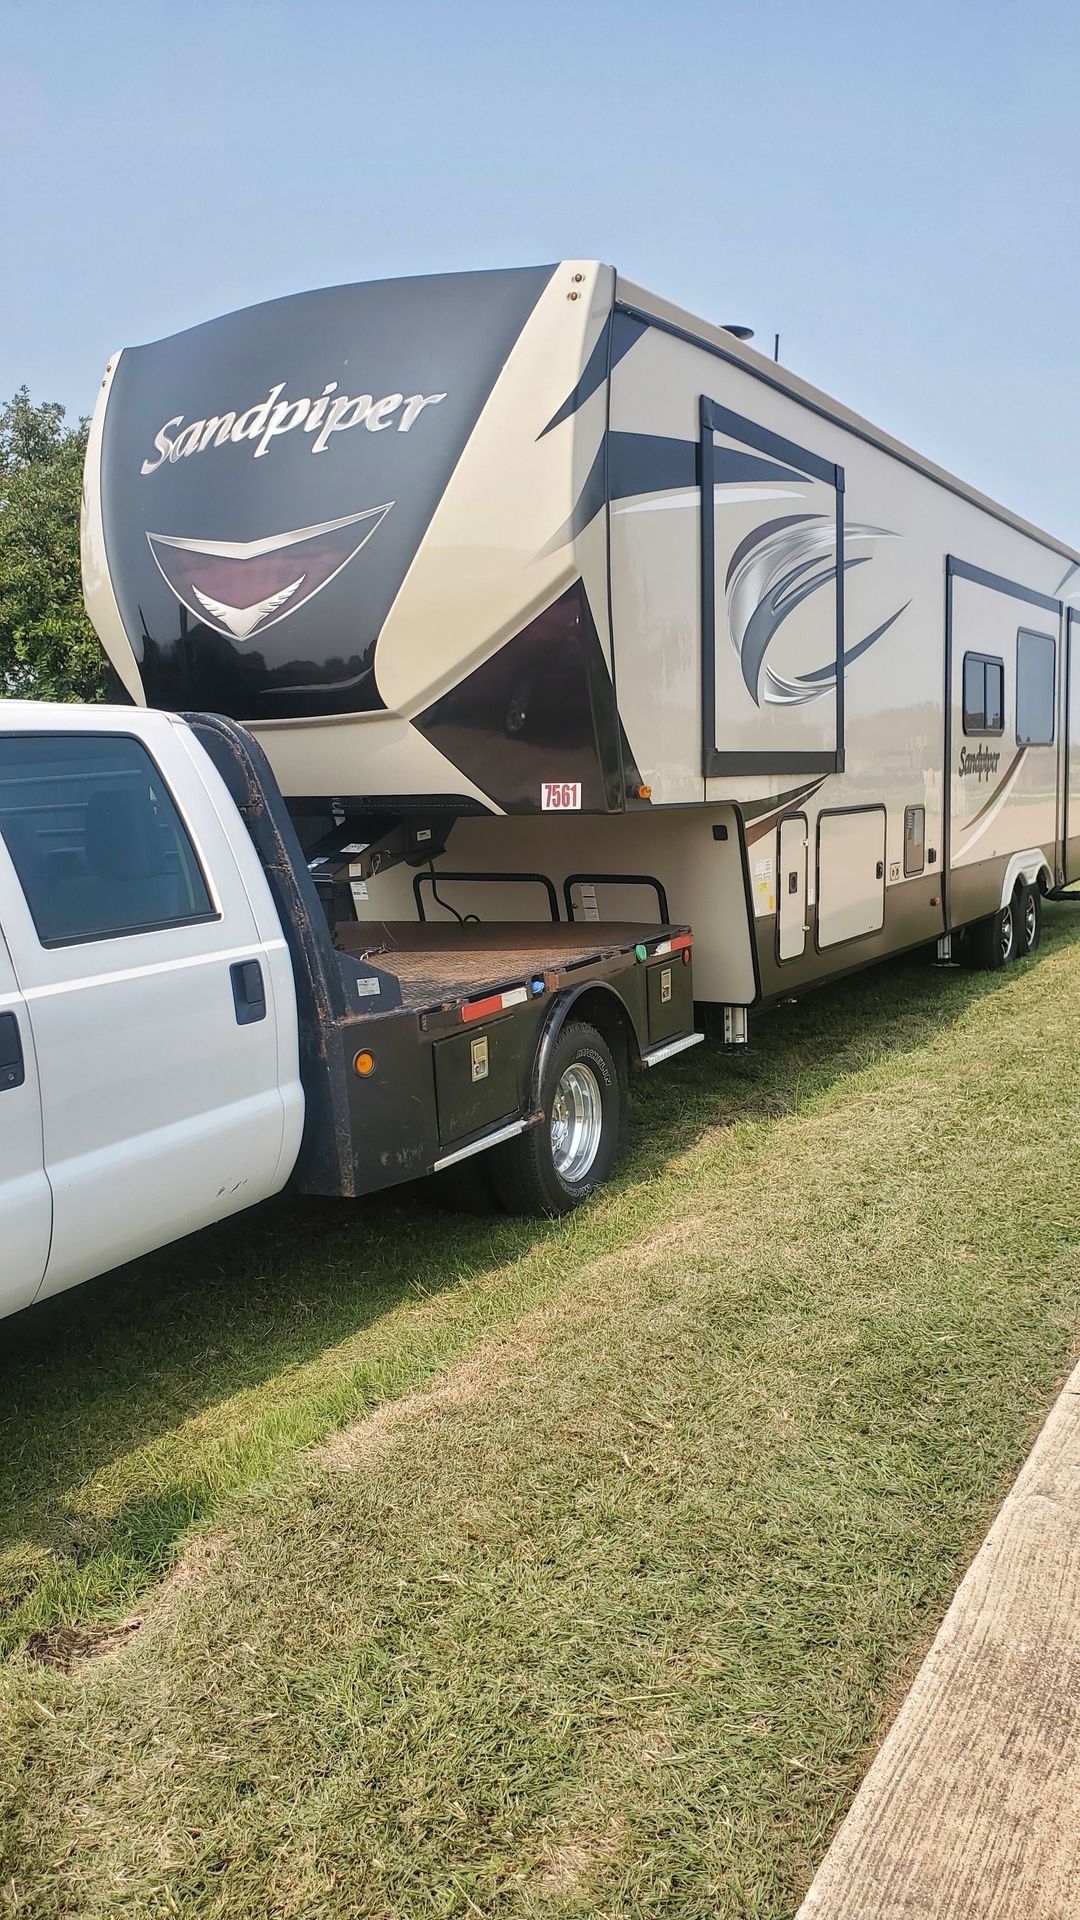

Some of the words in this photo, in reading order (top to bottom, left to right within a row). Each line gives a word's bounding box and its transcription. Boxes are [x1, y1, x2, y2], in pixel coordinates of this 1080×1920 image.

[140, 381, 447, 475] Sandpiper
[959, 743, 1000, 783] Sandpiper
[545, 784, 577, 807] 7561
[575, 1048, 612, 1087] MICHELIN
[553, 1162, 592, 1197] MICHE
